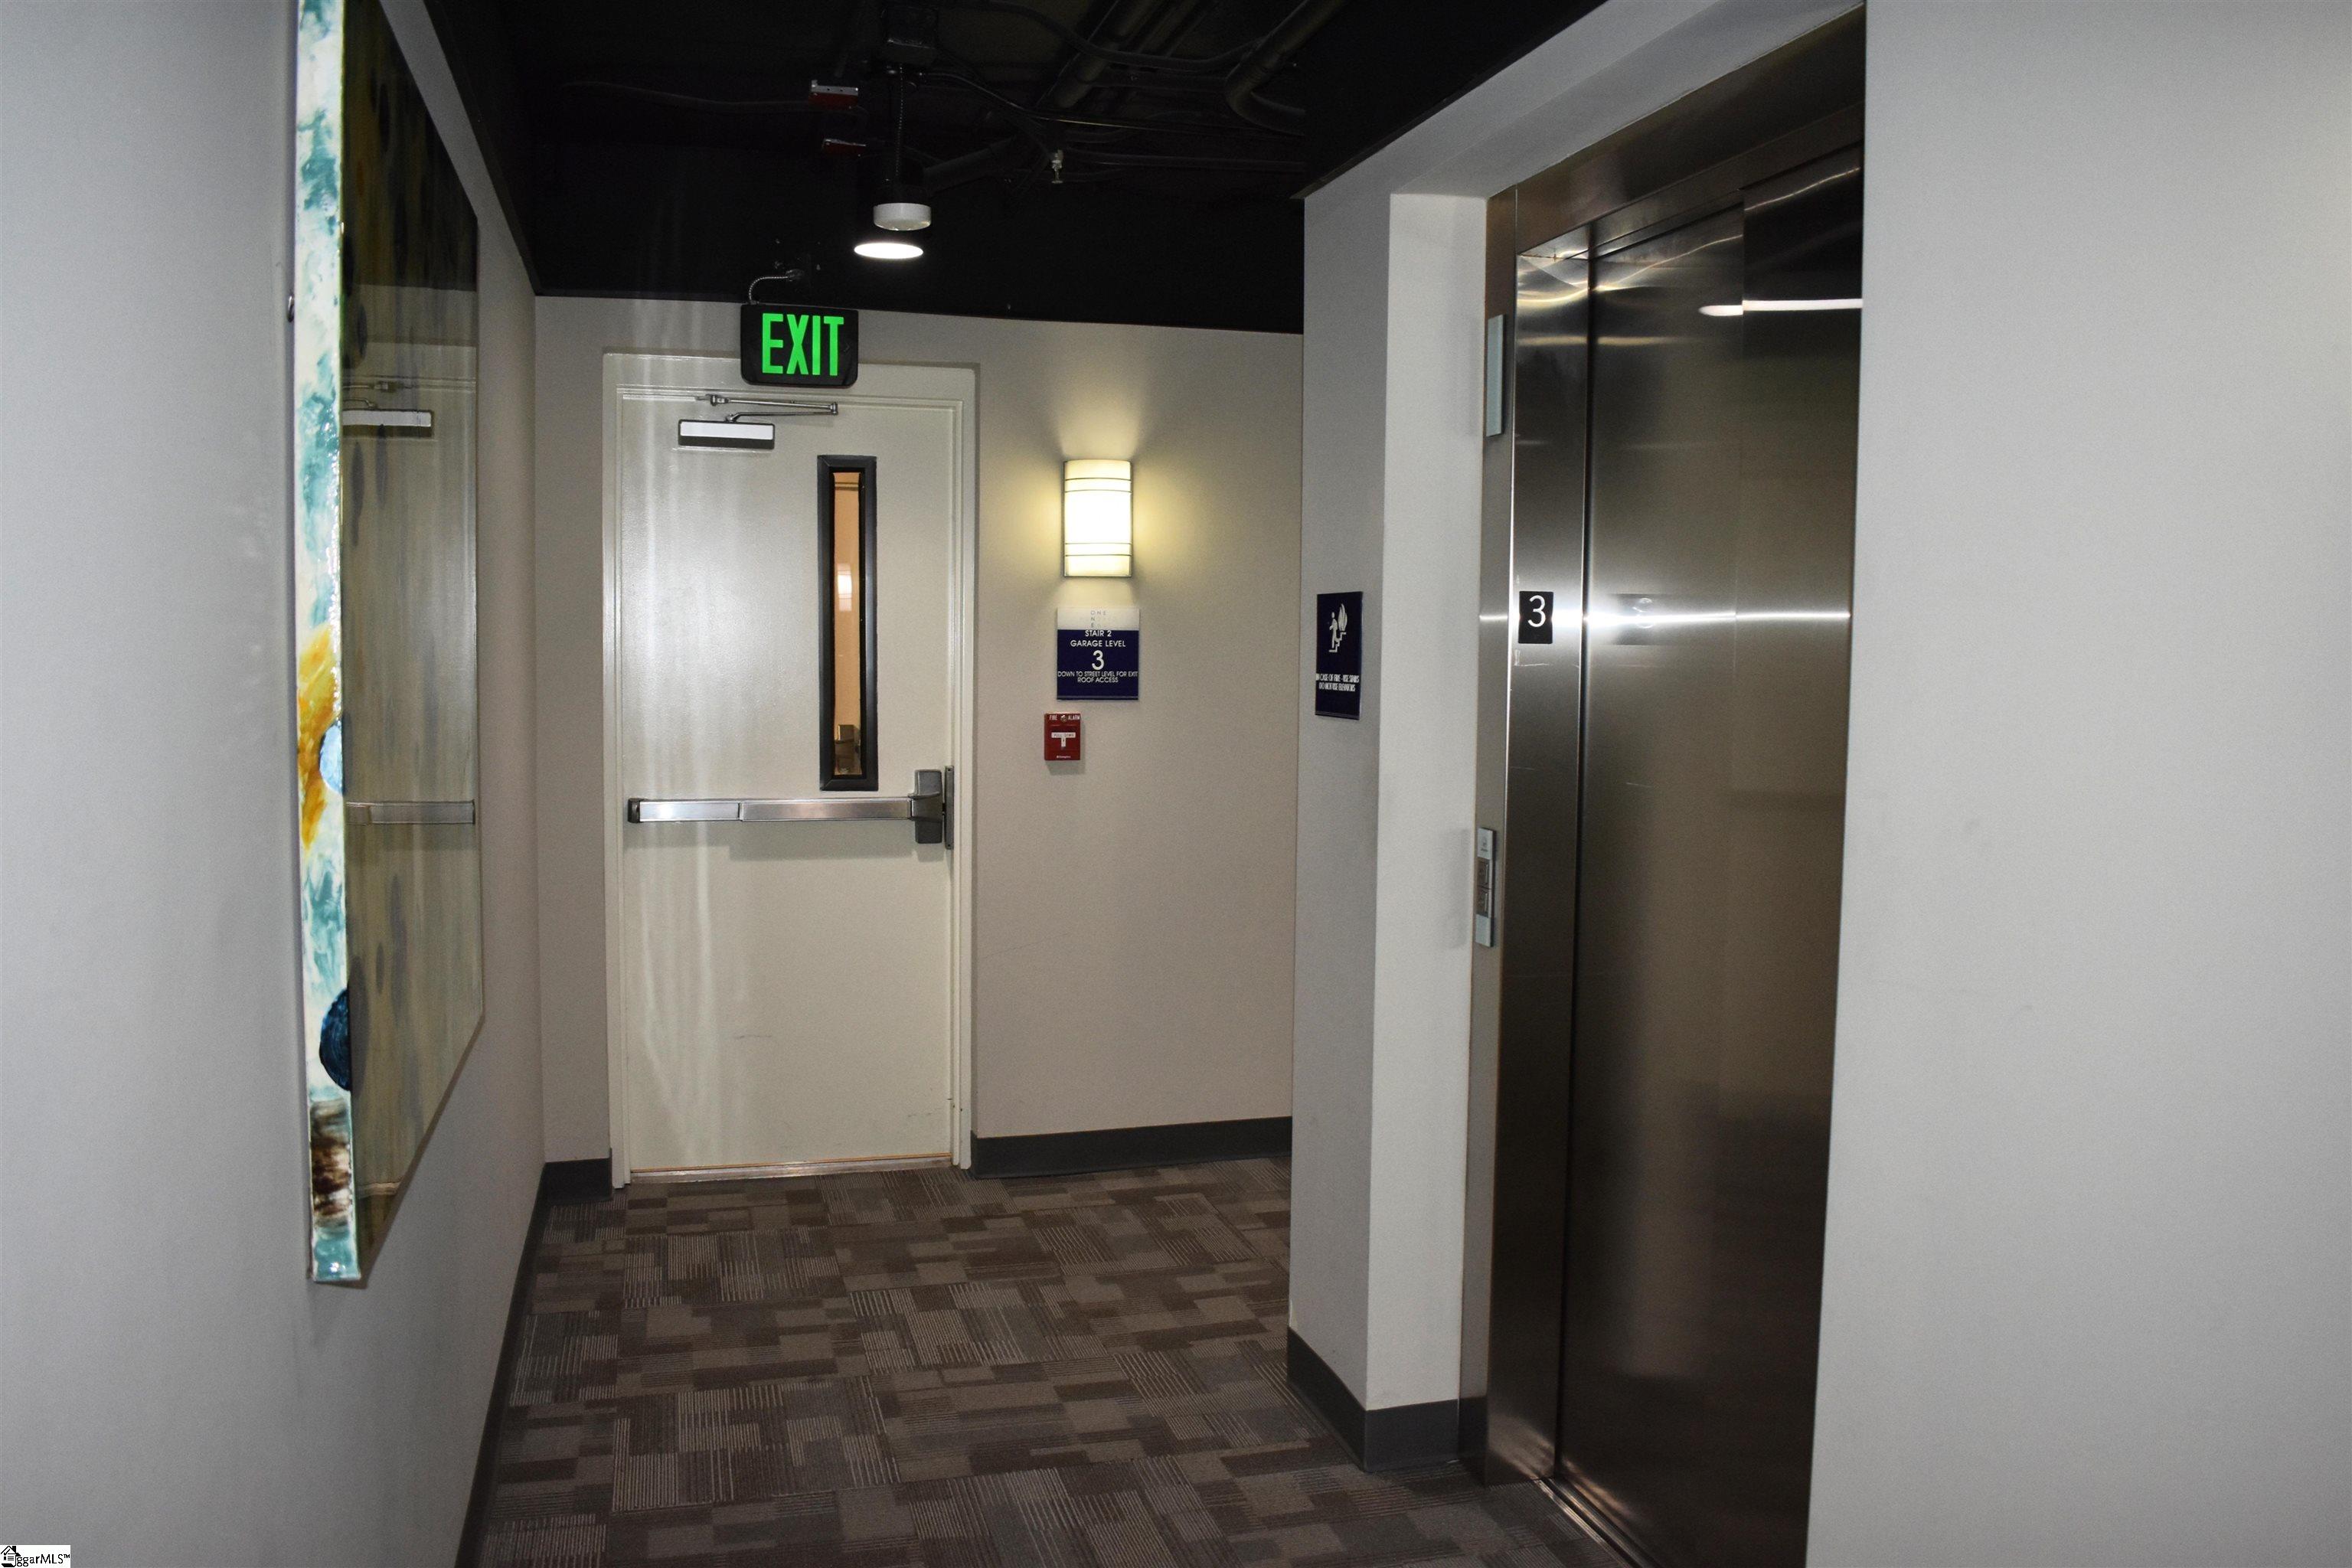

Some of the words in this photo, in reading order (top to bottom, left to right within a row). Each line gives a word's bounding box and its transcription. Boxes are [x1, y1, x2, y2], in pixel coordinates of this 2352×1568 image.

[762, 313, 844, 376] EXIT
[1527, 595, 1546, 627] 3
[1092, 650, 1105, 671] 3
